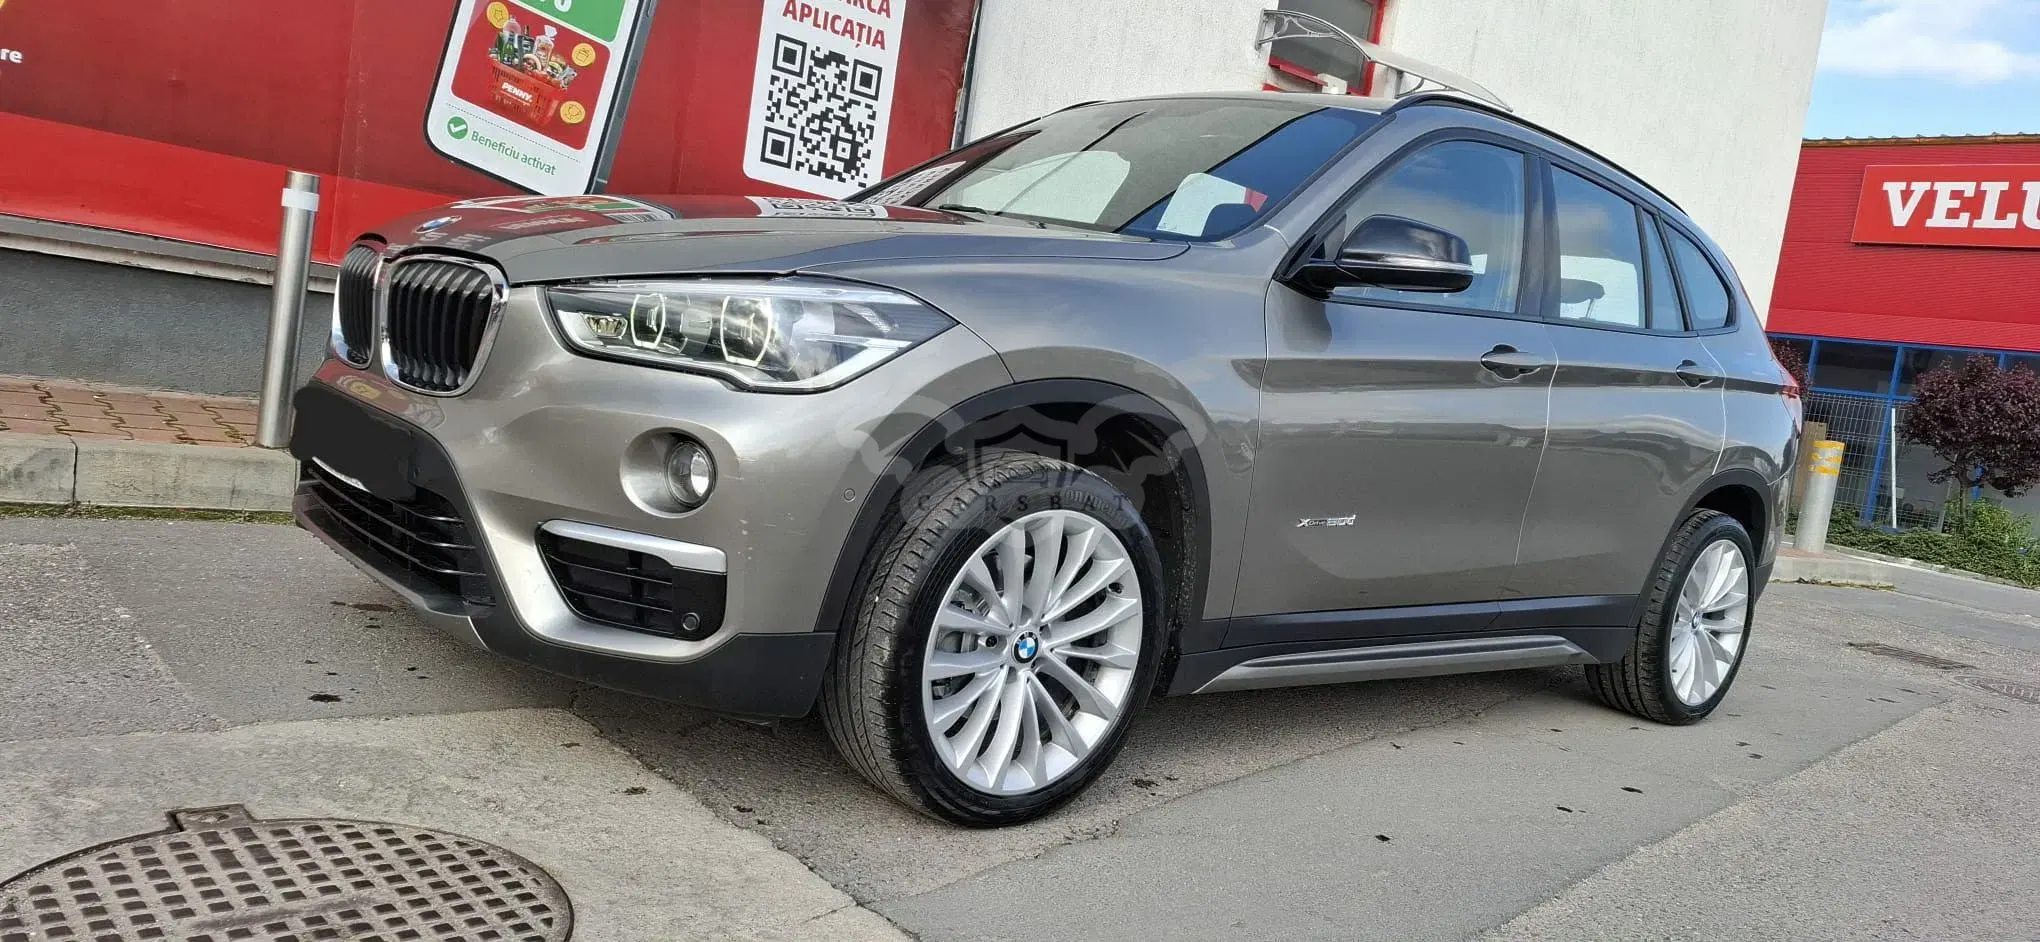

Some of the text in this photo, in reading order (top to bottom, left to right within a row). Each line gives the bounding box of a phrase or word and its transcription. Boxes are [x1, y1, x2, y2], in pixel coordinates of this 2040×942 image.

[782, 0, 886, 50] APLICAȚIA
[471, 131, 556, 175] Beneficiu activat
